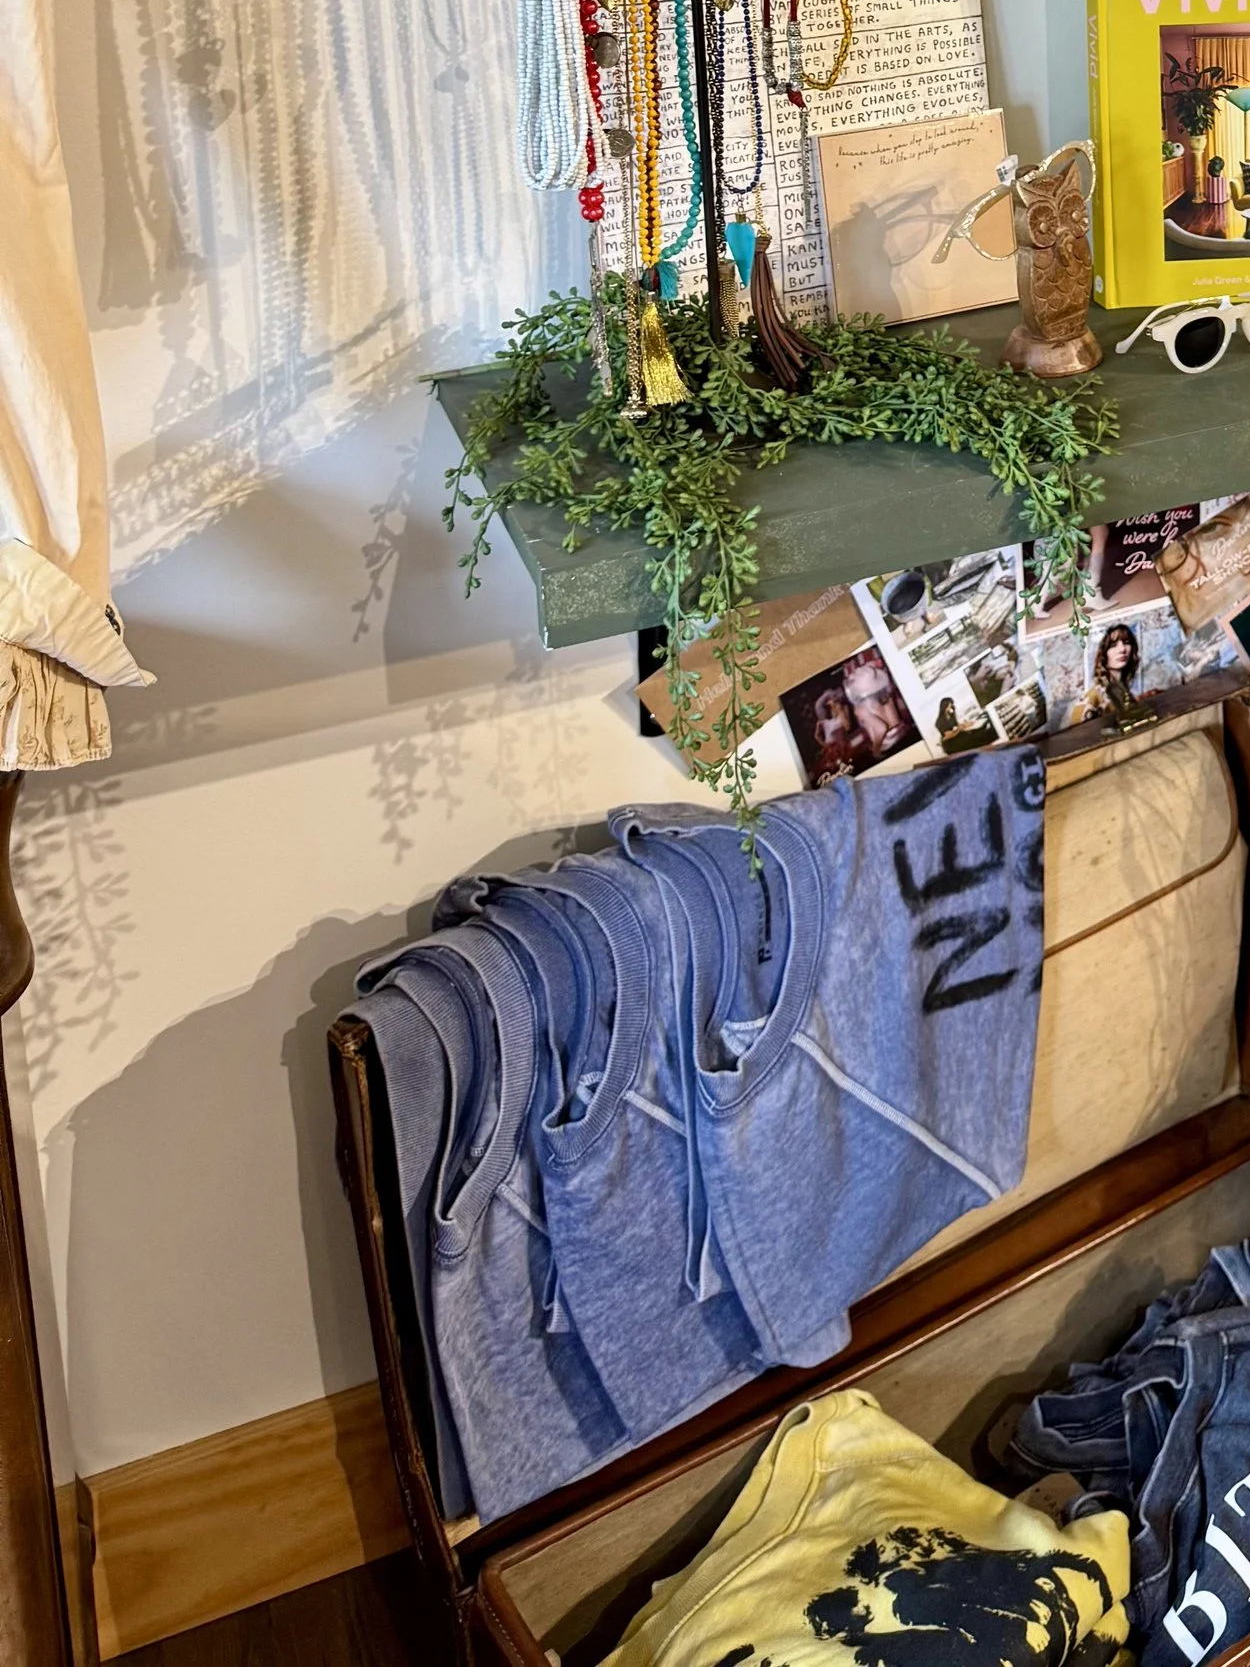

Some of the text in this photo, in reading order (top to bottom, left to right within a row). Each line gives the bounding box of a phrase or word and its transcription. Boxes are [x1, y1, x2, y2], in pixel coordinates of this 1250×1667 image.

[801, 7, 840, 21] SERIES
[866, 1, 903, 13] SMALL
[865, 34, 880, 45] IN
[885, 29, 912, 42] THE
[918, 25, 953, 37] ARTS,
[962, 21, 978, 32] AS
[916, 42, 927, 51] IS
[933, 34, 981, 50] POSSIBLE
[856, 64, 867, 74] IS
[874, 58, 910, 73] BASED
[916, 55, 932, 65] ON
[938, 48, 976, 63] LOVE.
[818, 89, 843, 101] SAID
[847, 81, 897, 96] NOTHING
[902, 78, 912, 88] IS
[861, 89, 921, 107] CHANGES.
[927, 79, 985, 97] EVERYTHING
[831, 104, 916, 128] EVERYTHING
[923, 92, 983, 110] EVOLVES,
[788, 273, 815, 288] BUT
[1192, 276, 1214, 287] Julia
[1214, 274, 1243, 286] Green
[1164, 508, 1194, 536] you
[1122, 530, 1159, 546] were
